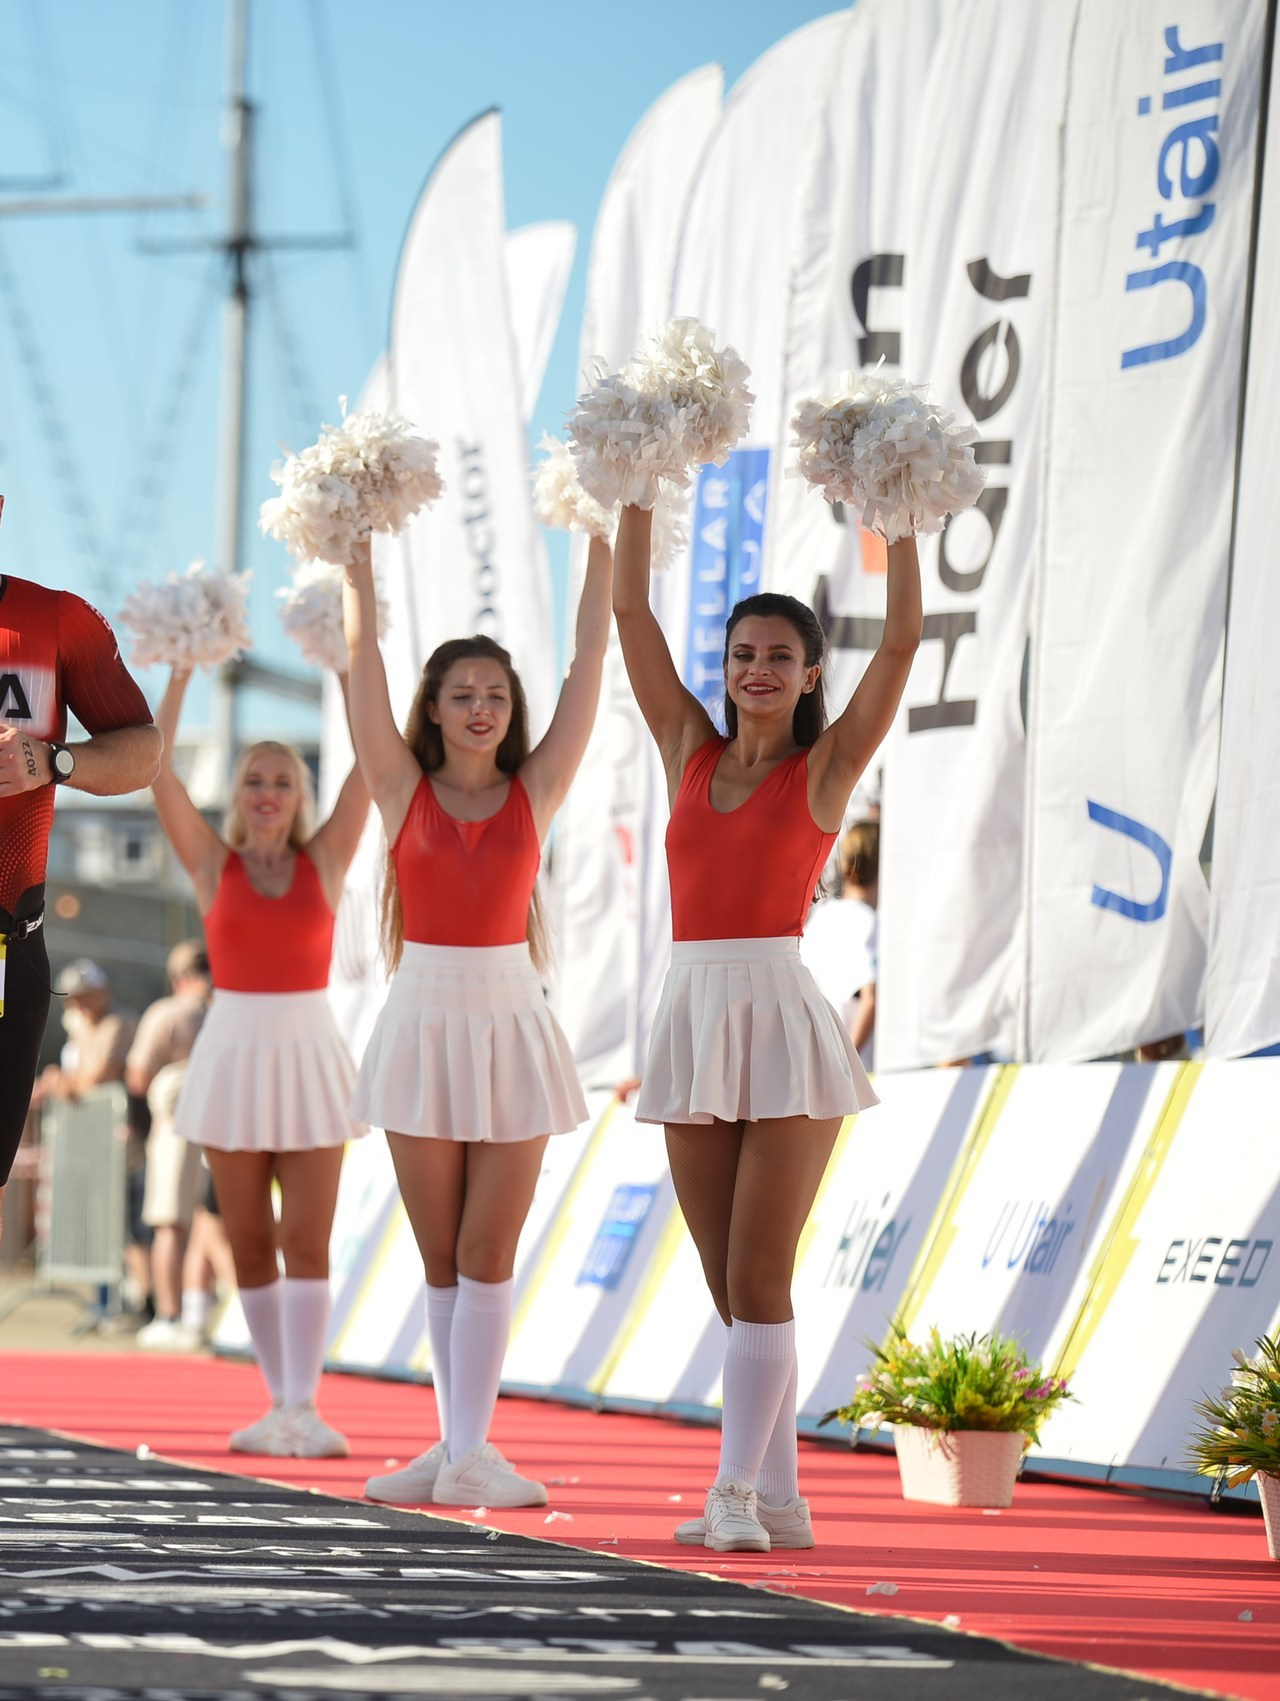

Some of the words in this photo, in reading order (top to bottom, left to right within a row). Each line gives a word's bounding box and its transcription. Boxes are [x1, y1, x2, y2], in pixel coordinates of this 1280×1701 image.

[1121, 25, 1224, 369] Utair
[908, 257, 1031, 734] Haier
[22, 739, 37, 777] 4022
[1156, 1235, 1273, 1287] EXEED
[25, 1512, 385, 1528] STAR
[200, 1565, 606, 1580] STAR
